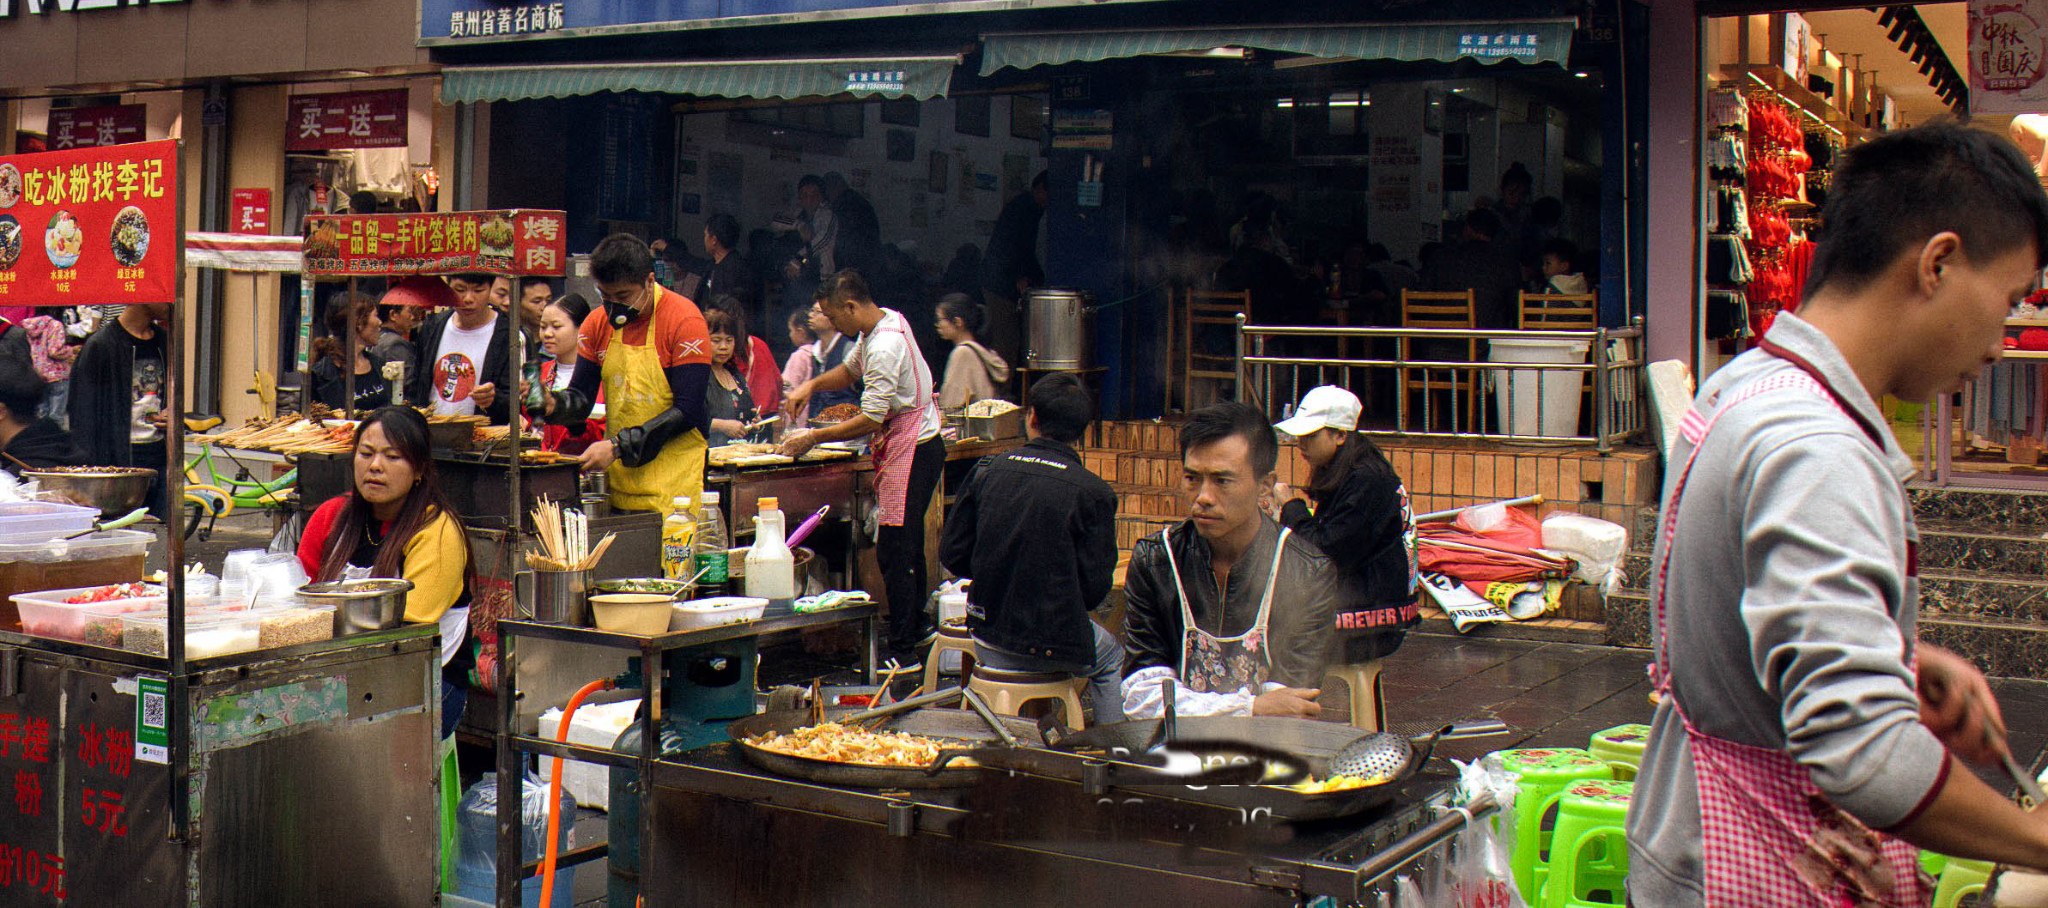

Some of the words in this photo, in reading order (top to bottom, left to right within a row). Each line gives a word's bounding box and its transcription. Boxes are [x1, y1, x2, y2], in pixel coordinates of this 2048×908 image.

[450, 3, 564, 38] 贵州省著名商标
[1982, 16, 2024, 55] 中秋
[1998, 46, 2037, 77] 国庆
[57, 117, 137, 148] 买二送一
[300, 104, 397, 138] 买二送一
[23, 159, 165, 206] 吃冰粉找李记
[242, 206, 265, 230] 买二
[336, 216, 478, 255] 一品留一手竹签烤肉
[523, 216, 560, 271] 烤肉
[50, 269, 77, 281] 水果冰粉
[56, 282, 70, 292] 10元
[117, 268, 145, 280] 绿豆冰粉
[124, 281, 136, 292] 5元
[0, 713, 50, 763] 手搓
[78, 721, 134, 777] 冰粉
[14, 768, 43, 817] 粉
[81, 787, 128, 837] 5元
